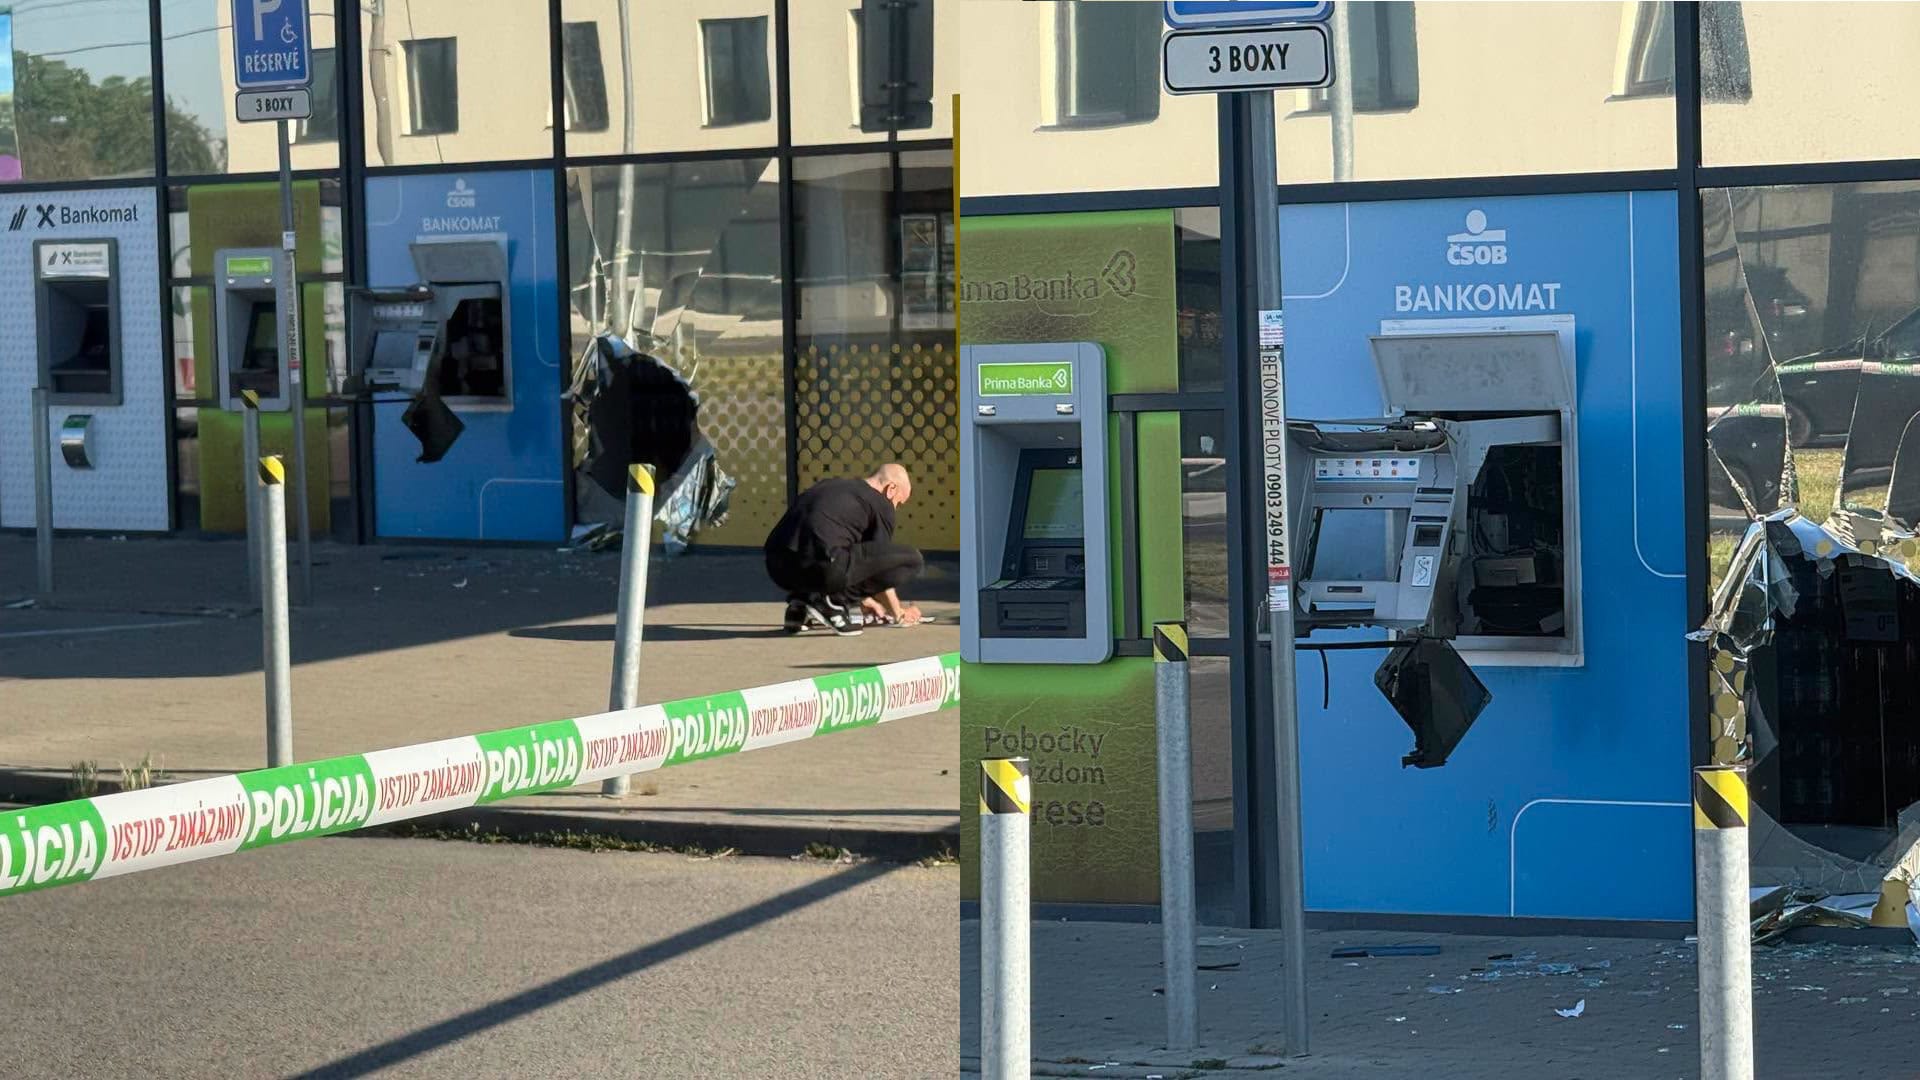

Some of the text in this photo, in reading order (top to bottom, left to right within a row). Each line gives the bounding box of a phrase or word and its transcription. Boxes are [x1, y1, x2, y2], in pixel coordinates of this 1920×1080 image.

[245, 47, 300, 73] RÉSERVÉ
[1208, 43, 1290, 74] 3 BOXY
[255, 97, 293, 112] 3 BOXY
[60, 204, 139, 225] Bankomat
[422, 216, 501, 233] BANKOMAT
[1446, 243, 1508, 266] ČSOB
[1014, 269, 1099, 301] Banka
[1395, 283, 1561, 312] BANKOMAT
[984, 376, 1053, 390] Prima Banka
[1262, 355, 1283, 426] BETÓNOVÉ
[1264, 429, 1281, 471] PLOTY
[1266, 473, 1282, 508] 0903
[1268, 511, 1283, 537] 249
[1269, 539, 1285, 566] 444
[984, 725, 1105, 759] Pobočky
[111, 817, 165, 861] VSTUP
[165, 793, 246, 851] ZAKÁZANÝ
[247, 768, 369, 842] POLÍCIA
[379, 772, 420, 811] VSTUP
[420, 752, 482, 802] ZAKÁZANÝ
[482, 730, 578, 796] POLÍCIA
[585, 736, 619, 770] VSTUP
[618, 719, 668, 764] ZAKÁZANÝ
[668, 700, 745, 760] POLÍCIA
[751, 706, 778, 737] VSTUP
[778, 692, 818, 732] ZAKÁZANÝ
[819, 675, 882, 729] POLÍCIA
[886, 681, 910, 710] VSTUP
[909, 668, 943, 704] ZAKÁZANÝ
